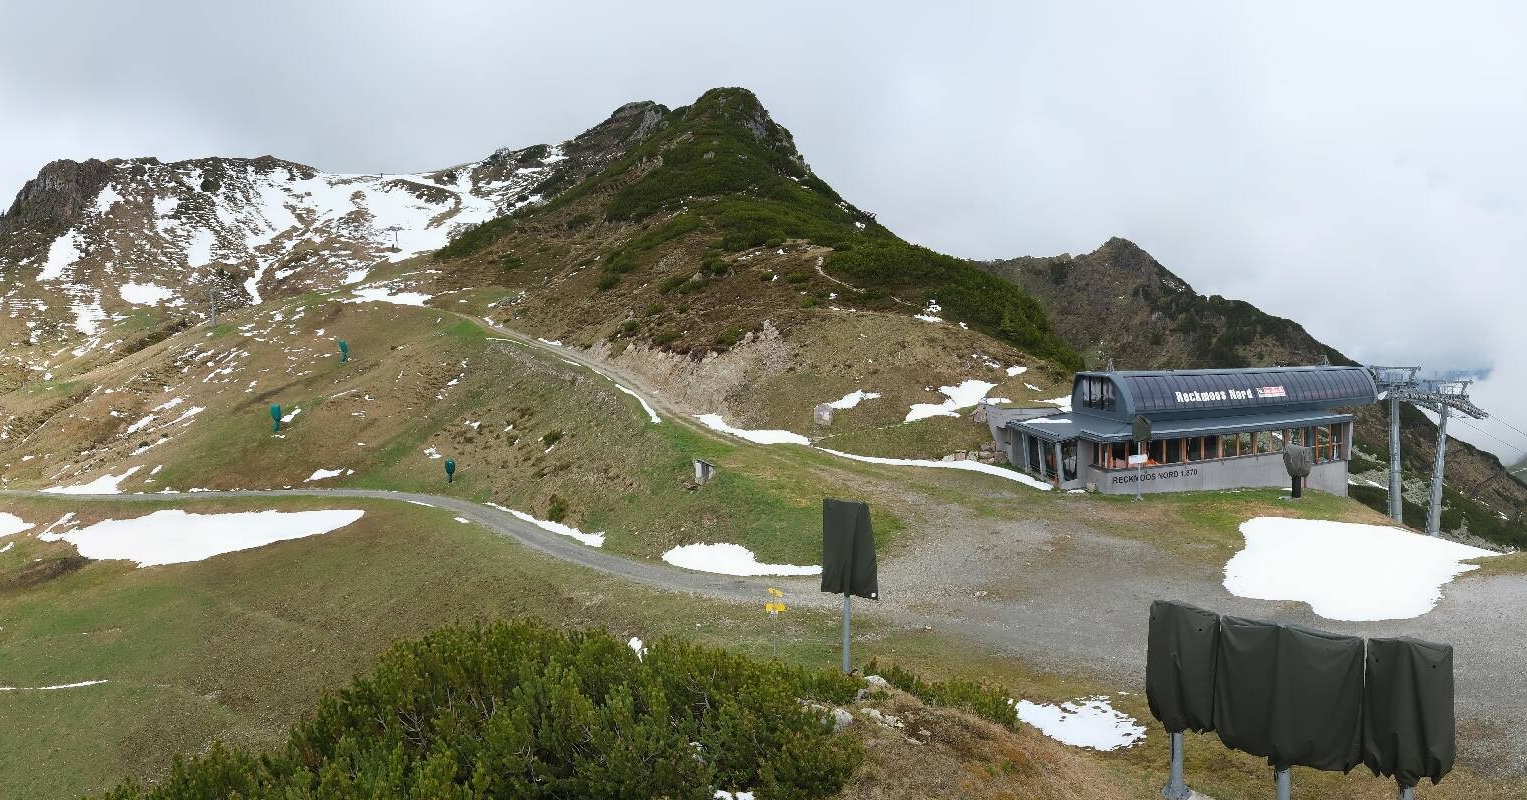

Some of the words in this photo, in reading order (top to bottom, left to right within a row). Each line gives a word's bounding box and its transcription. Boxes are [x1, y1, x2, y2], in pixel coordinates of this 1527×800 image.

[1175, 391, 1227, 402] Reckmoos
[1228, 388, 1254, 400] Nord
[1158, 470, 1179, 480] NORD
